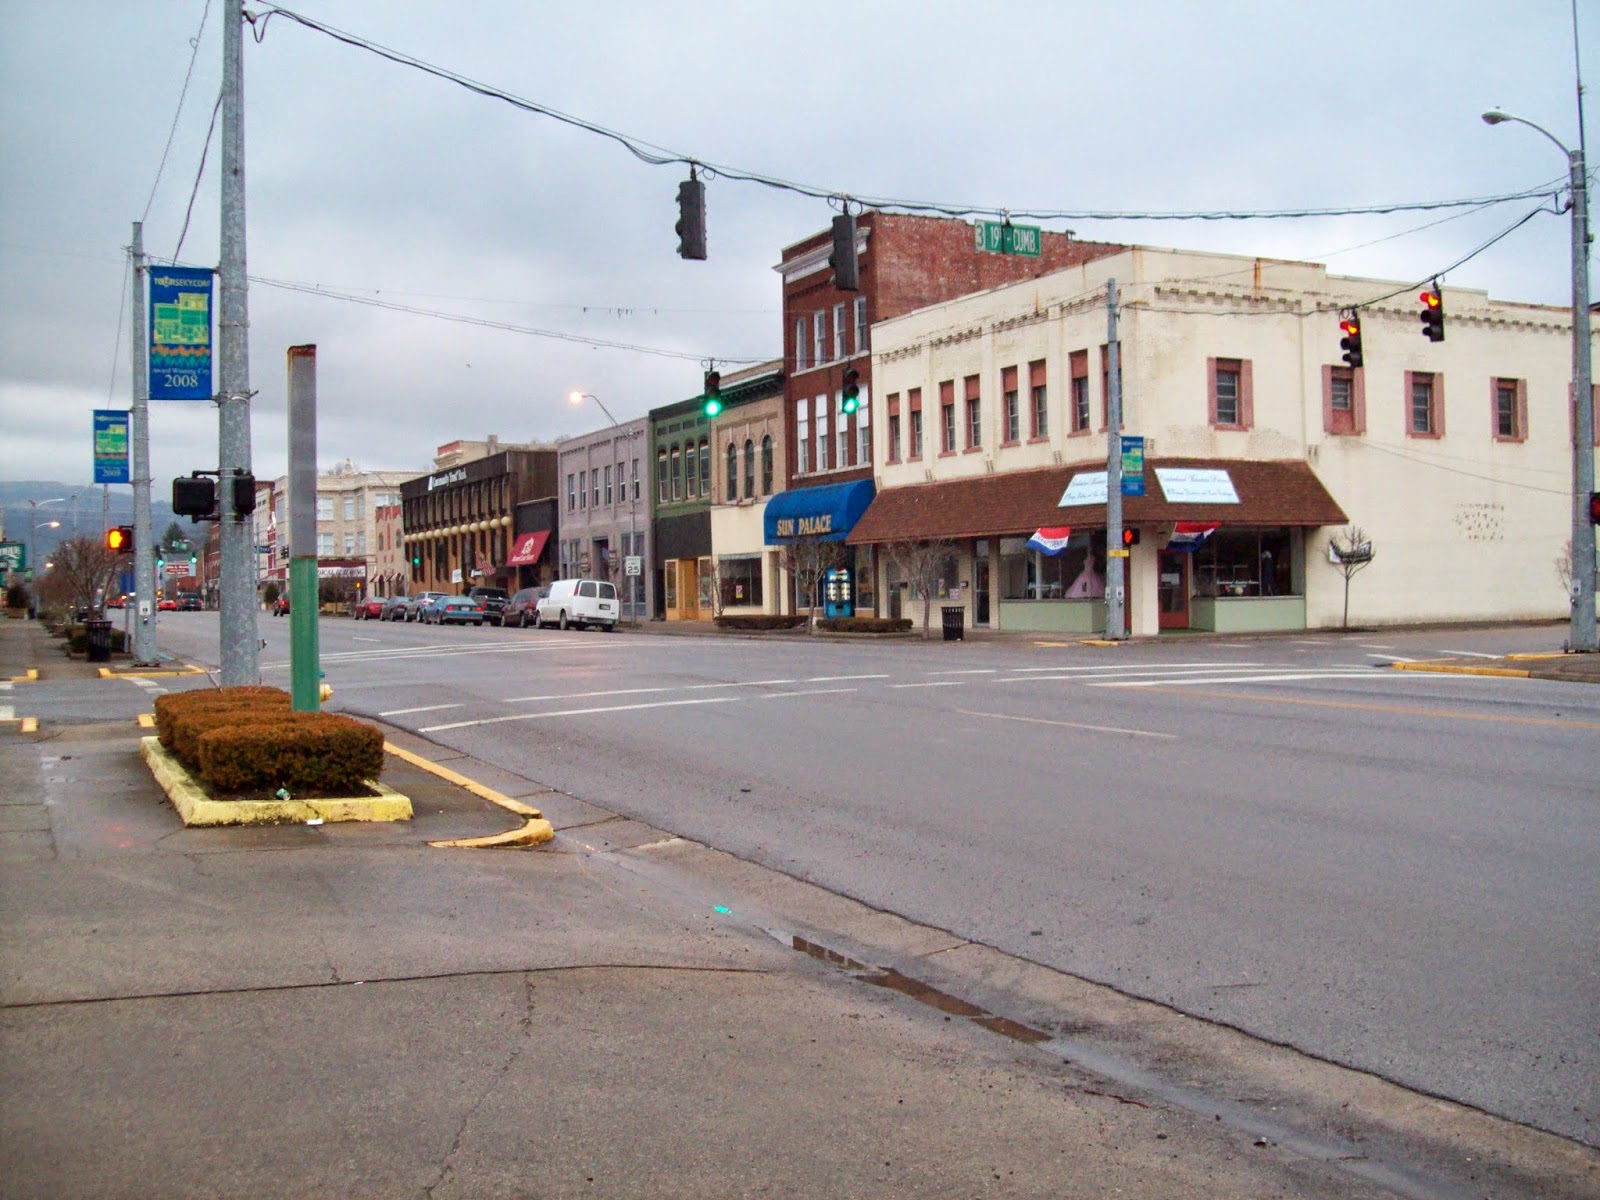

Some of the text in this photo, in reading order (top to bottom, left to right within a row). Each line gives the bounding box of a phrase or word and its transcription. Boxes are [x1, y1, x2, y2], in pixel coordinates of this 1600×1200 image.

[164, 374, 198, 388] 2008
[777, 514, 832, 536] SUN PALACE
[627, 565, 639, 574] 25
